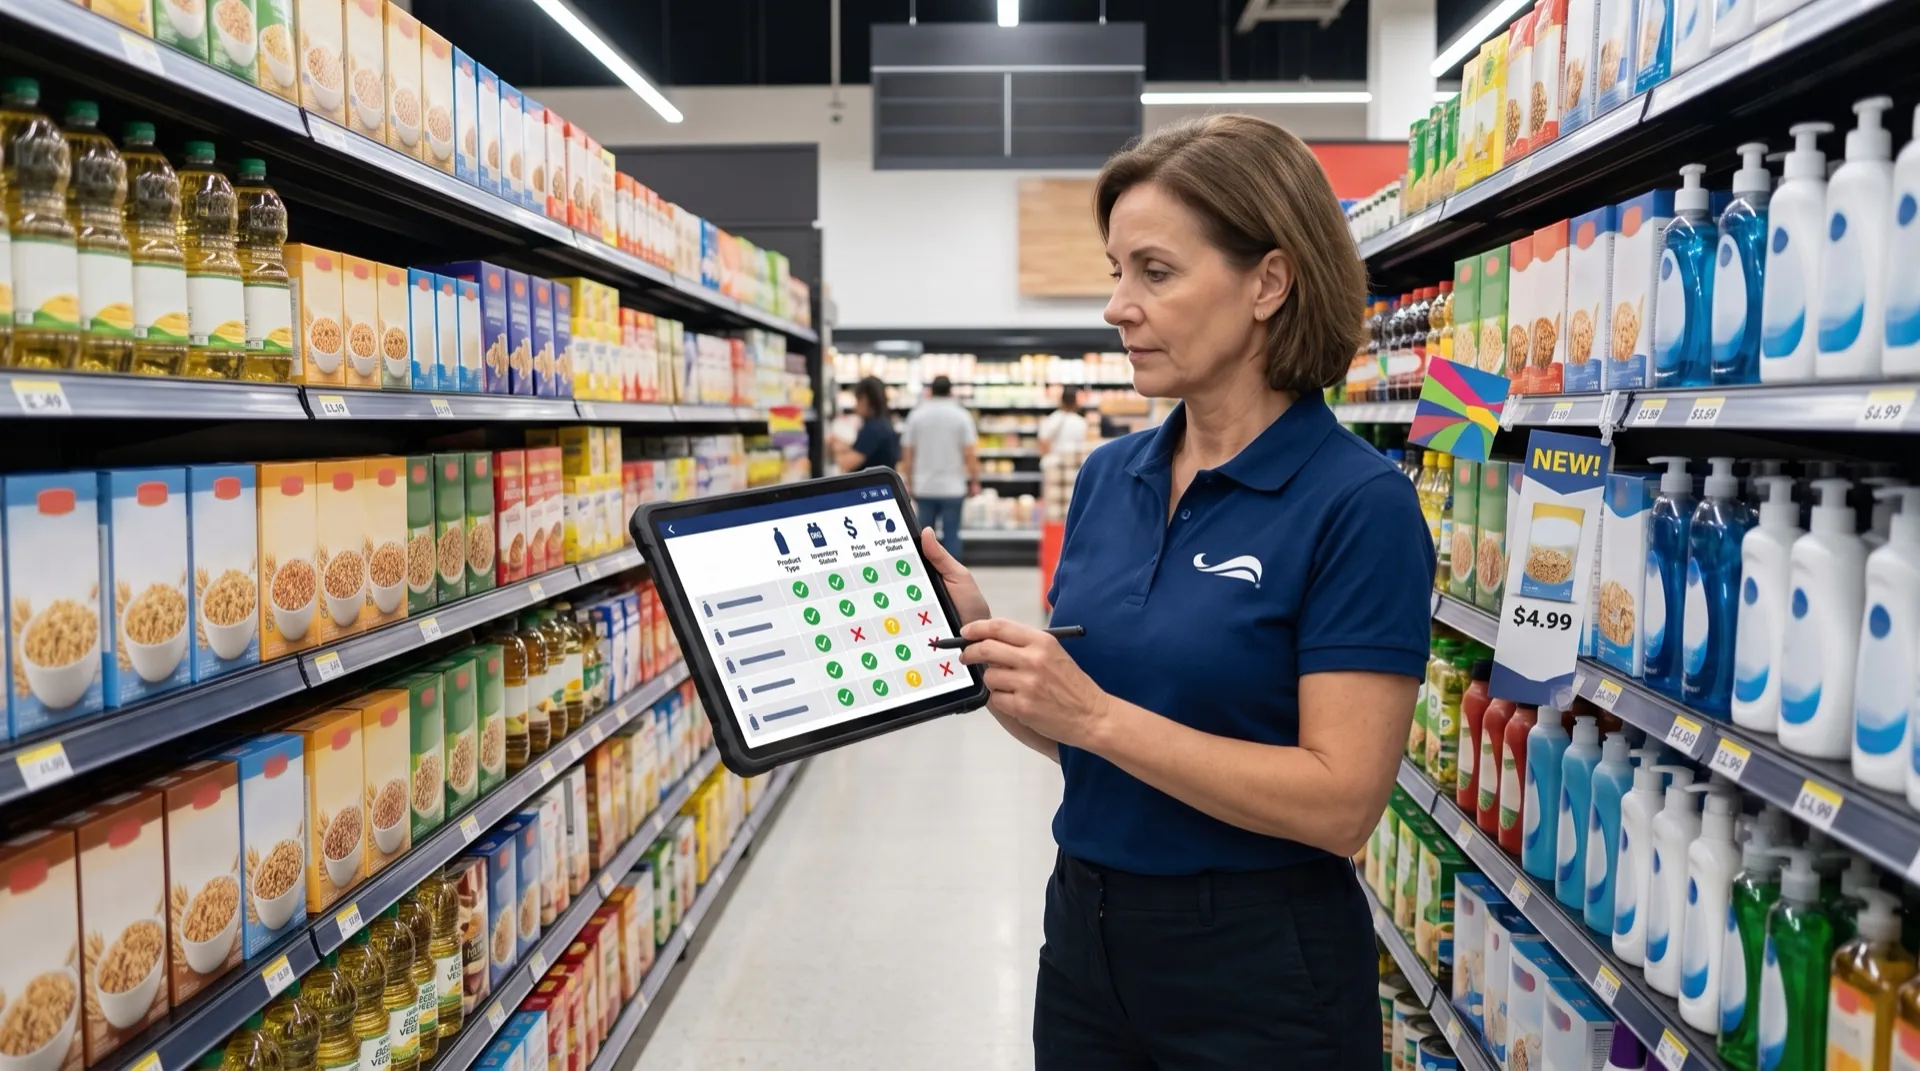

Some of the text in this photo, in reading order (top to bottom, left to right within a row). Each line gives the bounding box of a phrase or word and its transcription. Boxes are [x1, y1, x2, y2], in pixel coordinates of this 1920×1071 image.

[1532, 447, 1601, 477] NEW!
[810, 550, 839, 560] Inventory
[777, 556, 802, 567] Product
[785, 565, 800, 574] Type
[1513, 604, 1572, 631] $4.99
